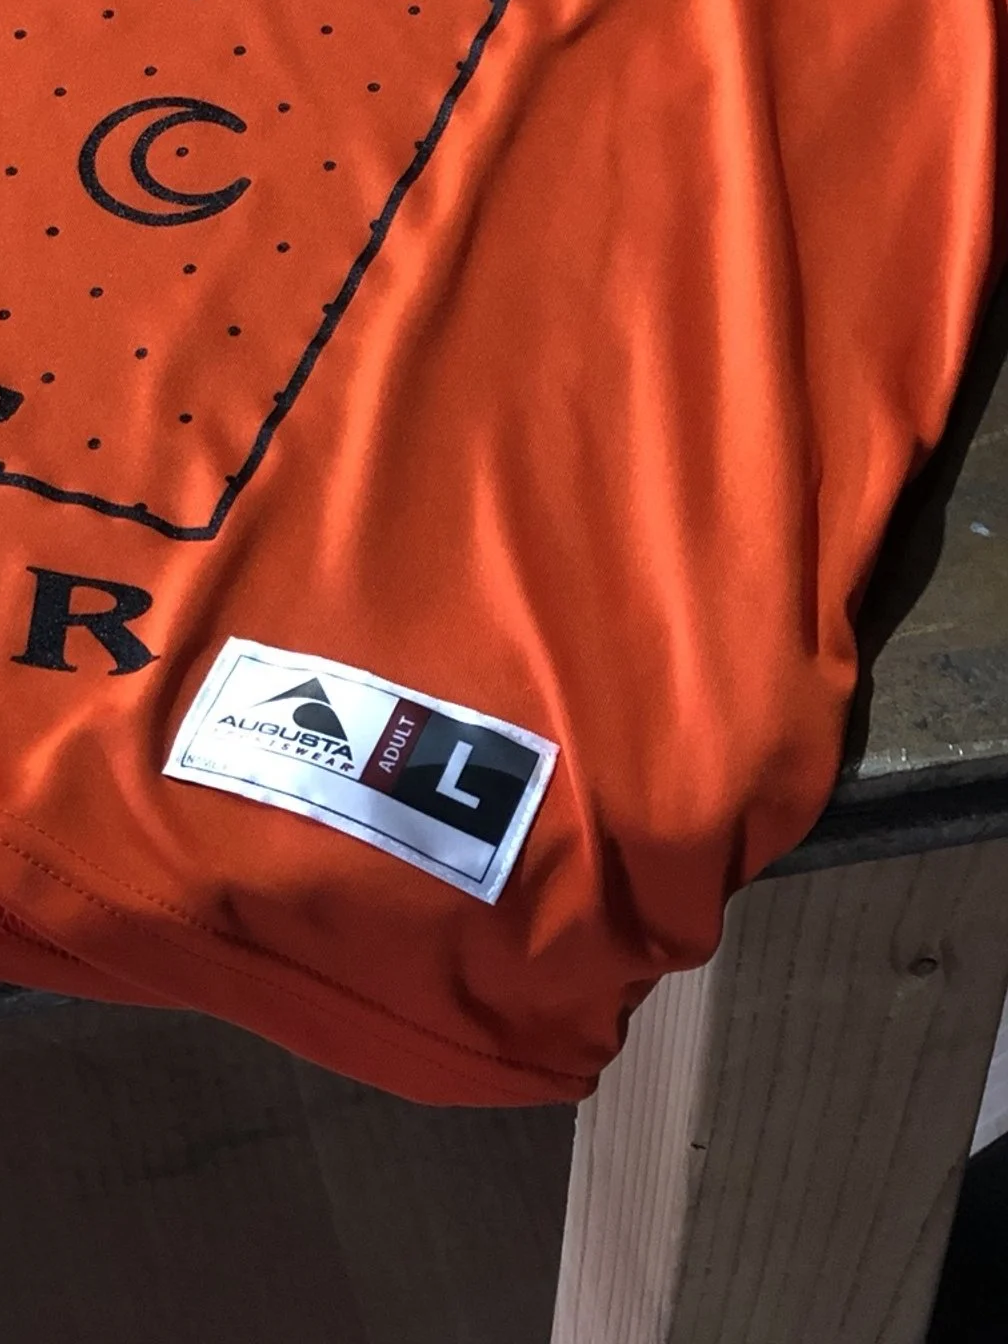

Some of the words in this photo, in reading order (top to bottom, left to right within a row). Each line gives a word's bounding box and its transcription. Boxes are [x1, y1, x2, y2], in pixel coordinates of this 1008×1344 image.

[217, 714, 354, 762] AUGUSTA
[378, 715, 416, 774] ADULT
[435, 739, 481, 810] L
